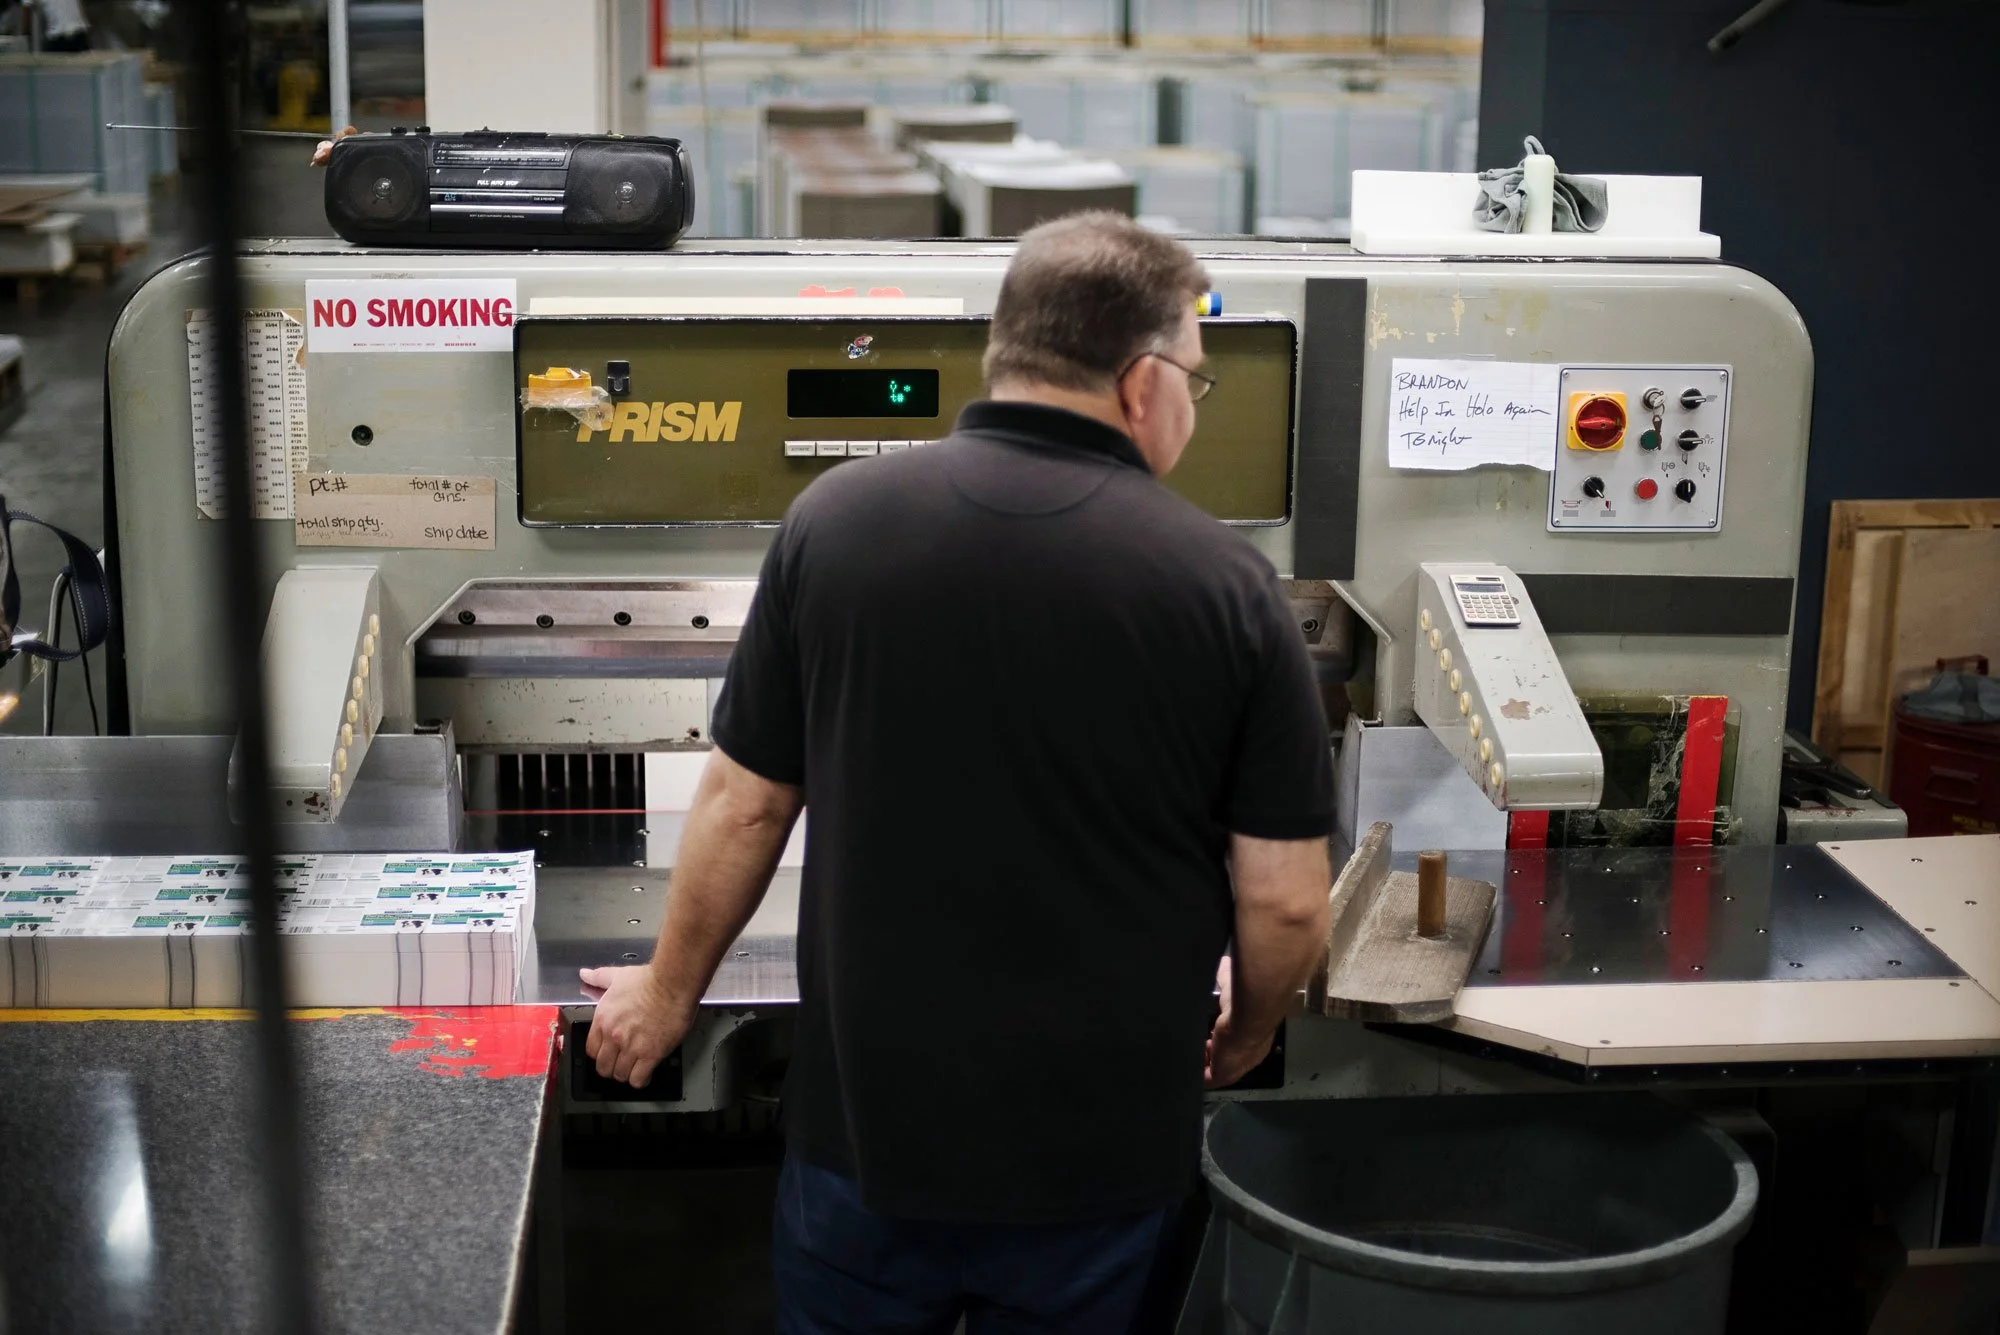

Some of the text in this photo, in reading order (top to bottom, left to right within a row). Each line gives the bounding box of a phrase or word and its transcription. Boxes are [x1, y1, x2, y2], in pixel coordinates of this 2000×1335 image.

[313, 298, 513, 328] NO SMOKING
[1395, 372, 1469, 391] BRANDON
[1399, 395, 1429, 425] Help
[1435, 401, 1455, 416] In
[1504, 401, 1552, 420] Again
[576, 401, 742, 443] PRISM
[409, 477, 470, 492] total # of
[297, 516, 384, 533] total ship qty.
[424, 525, 489, 541] ship date
